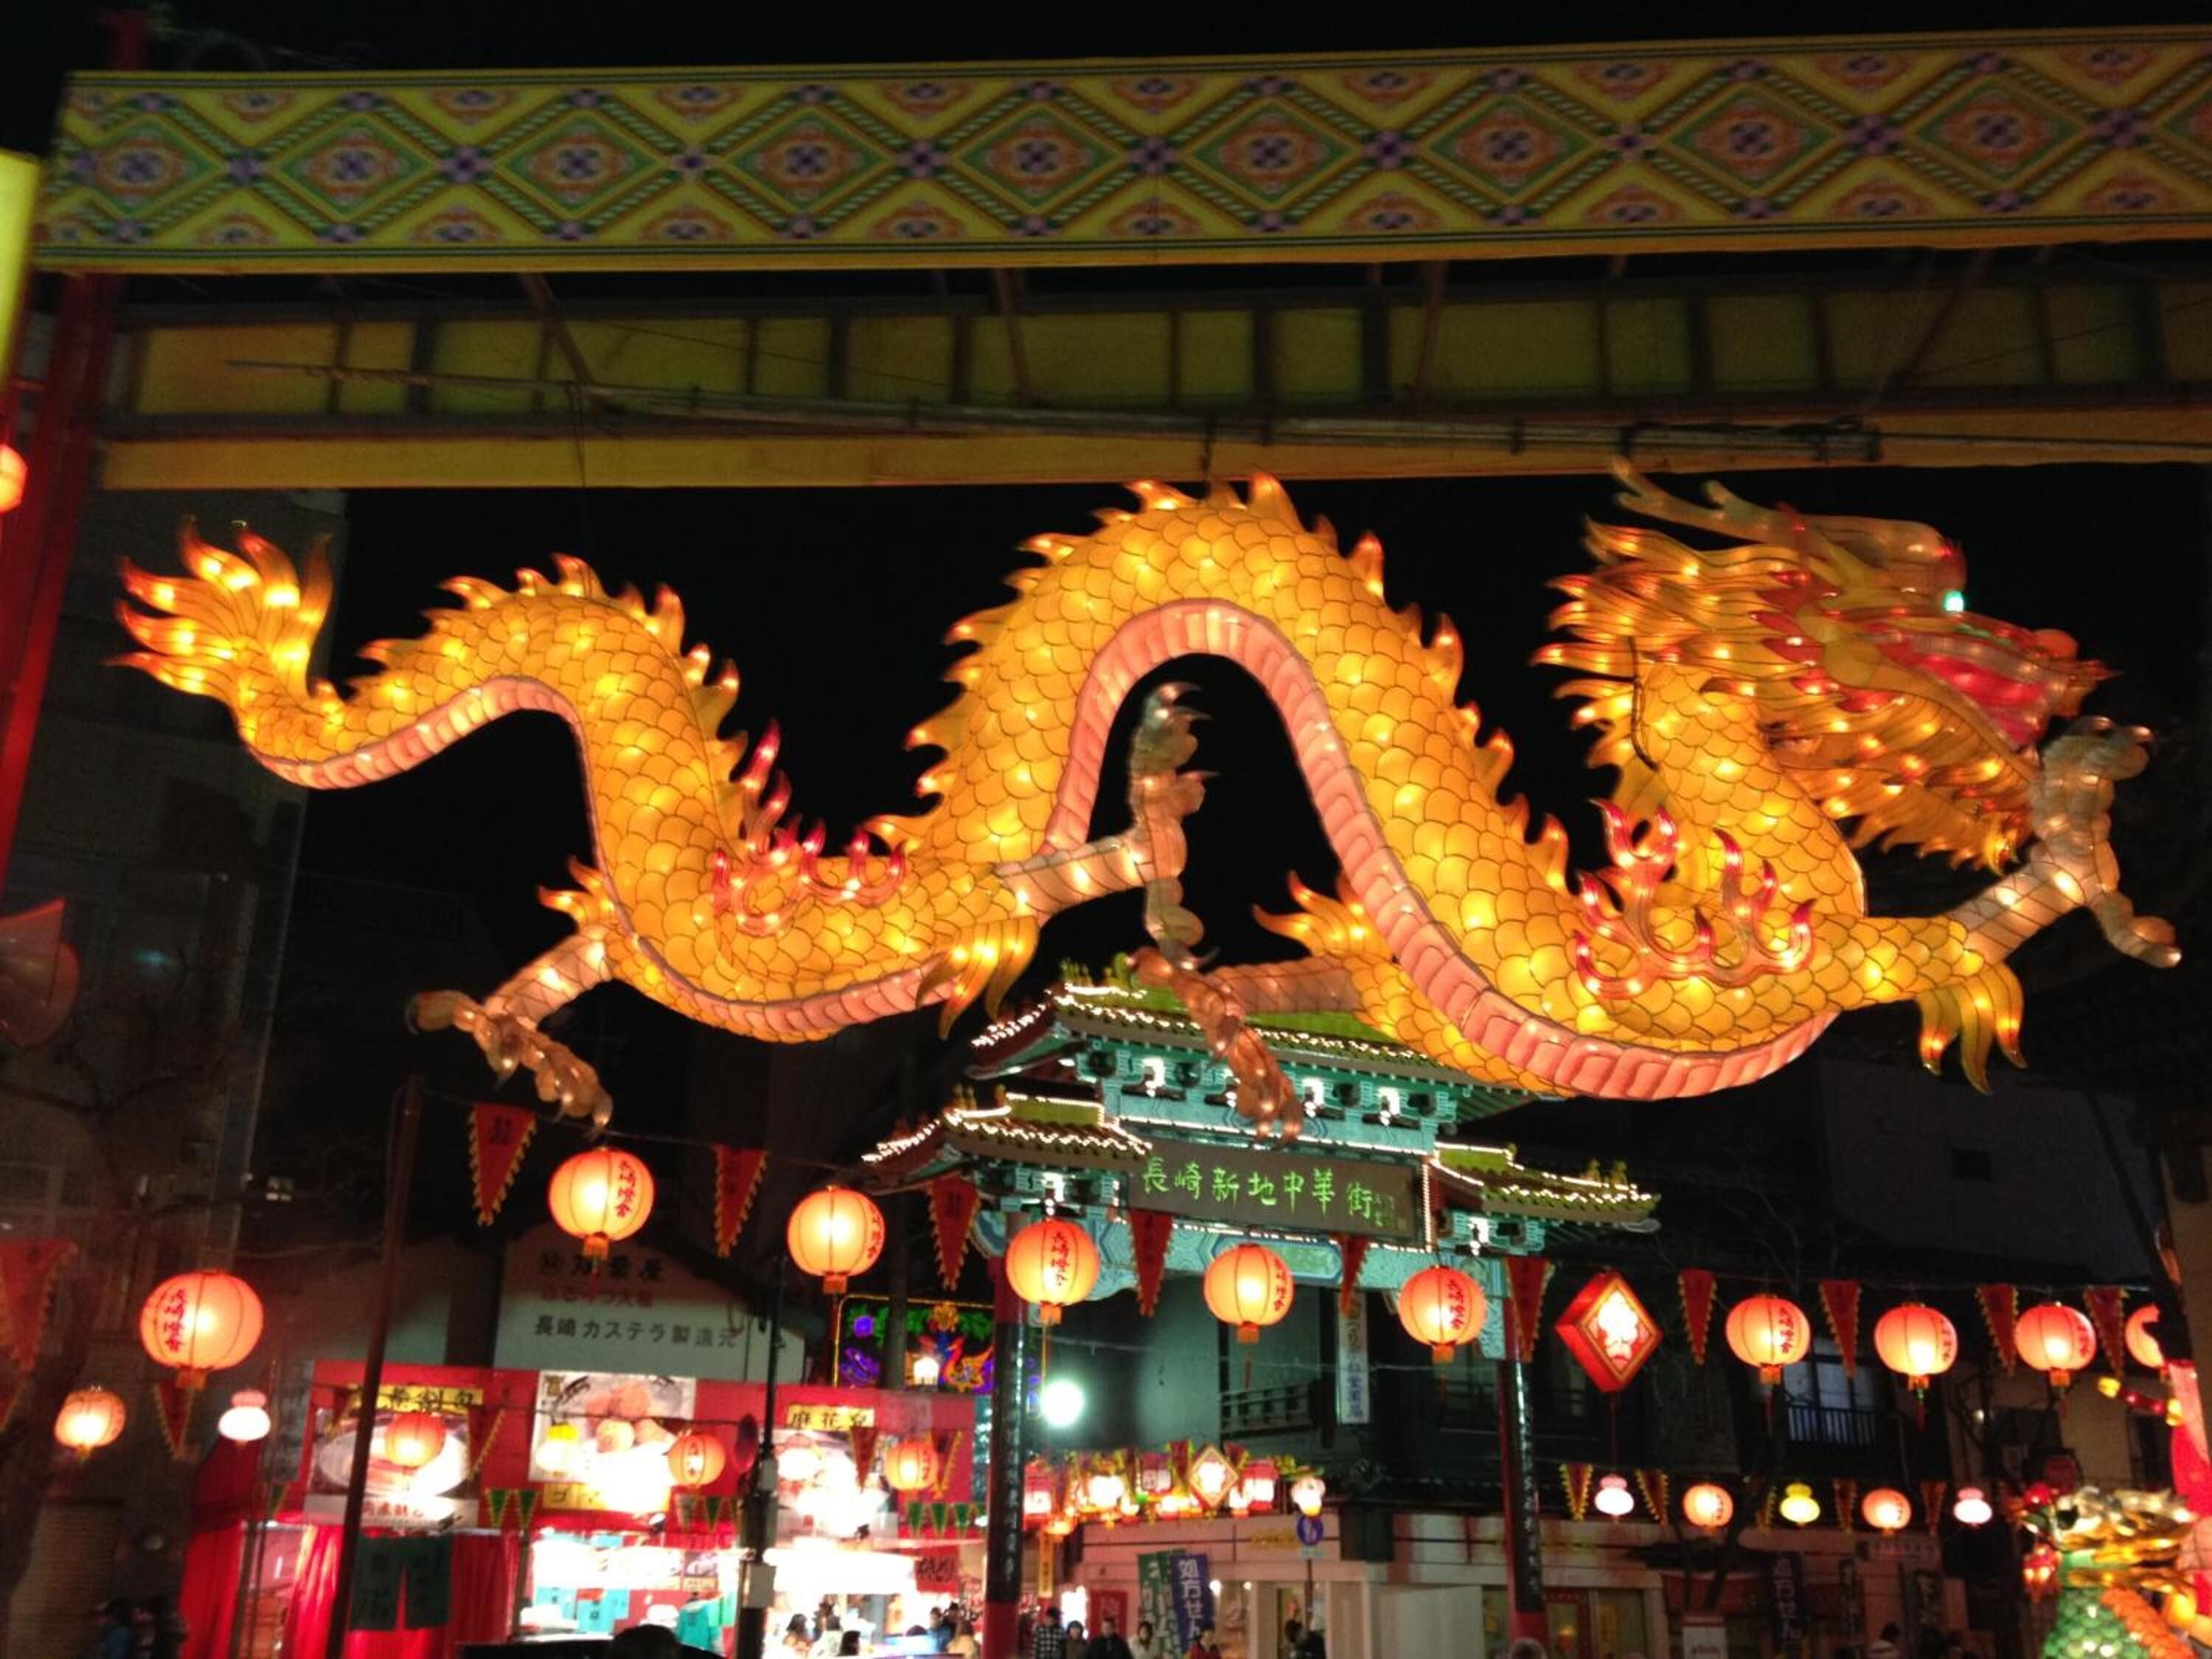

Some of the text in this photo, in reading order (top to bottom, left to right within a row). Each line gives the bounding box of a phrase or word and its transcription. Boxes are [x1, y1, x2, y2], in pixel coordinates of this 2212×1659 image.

[1143, 1155, 1373, 1219] 長崎新地中華街
[534, 1315, 737, 1348] 長崎カステラ製造元
